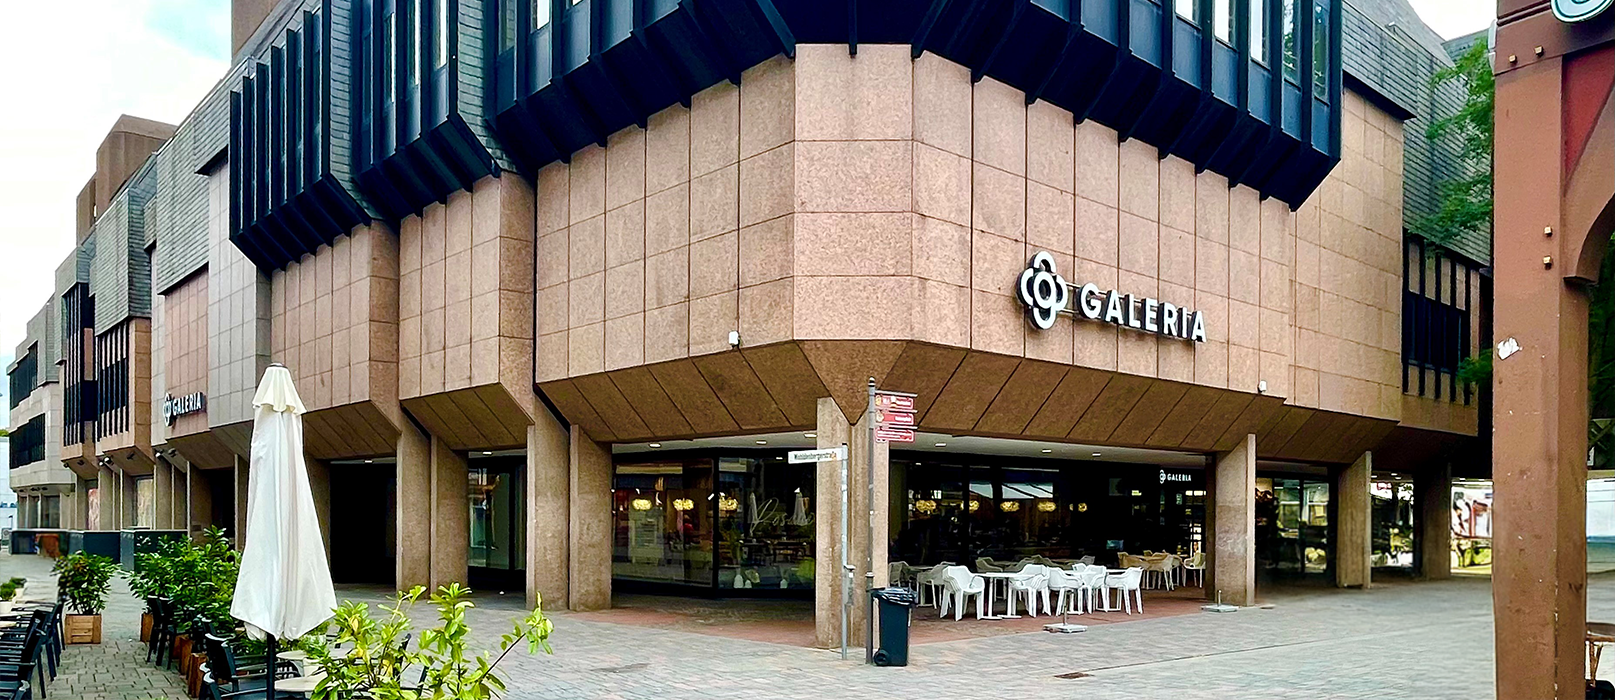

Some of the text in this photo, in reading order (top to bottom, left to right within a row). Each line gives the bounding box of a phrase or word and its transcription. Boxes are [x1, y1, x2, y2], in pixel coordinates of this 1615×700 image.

[1078, 282, 1206, 343] GALERIA
[172, 391, 202, 416] GALERIA
[1167, 473, 1192, 482] GALERIA
